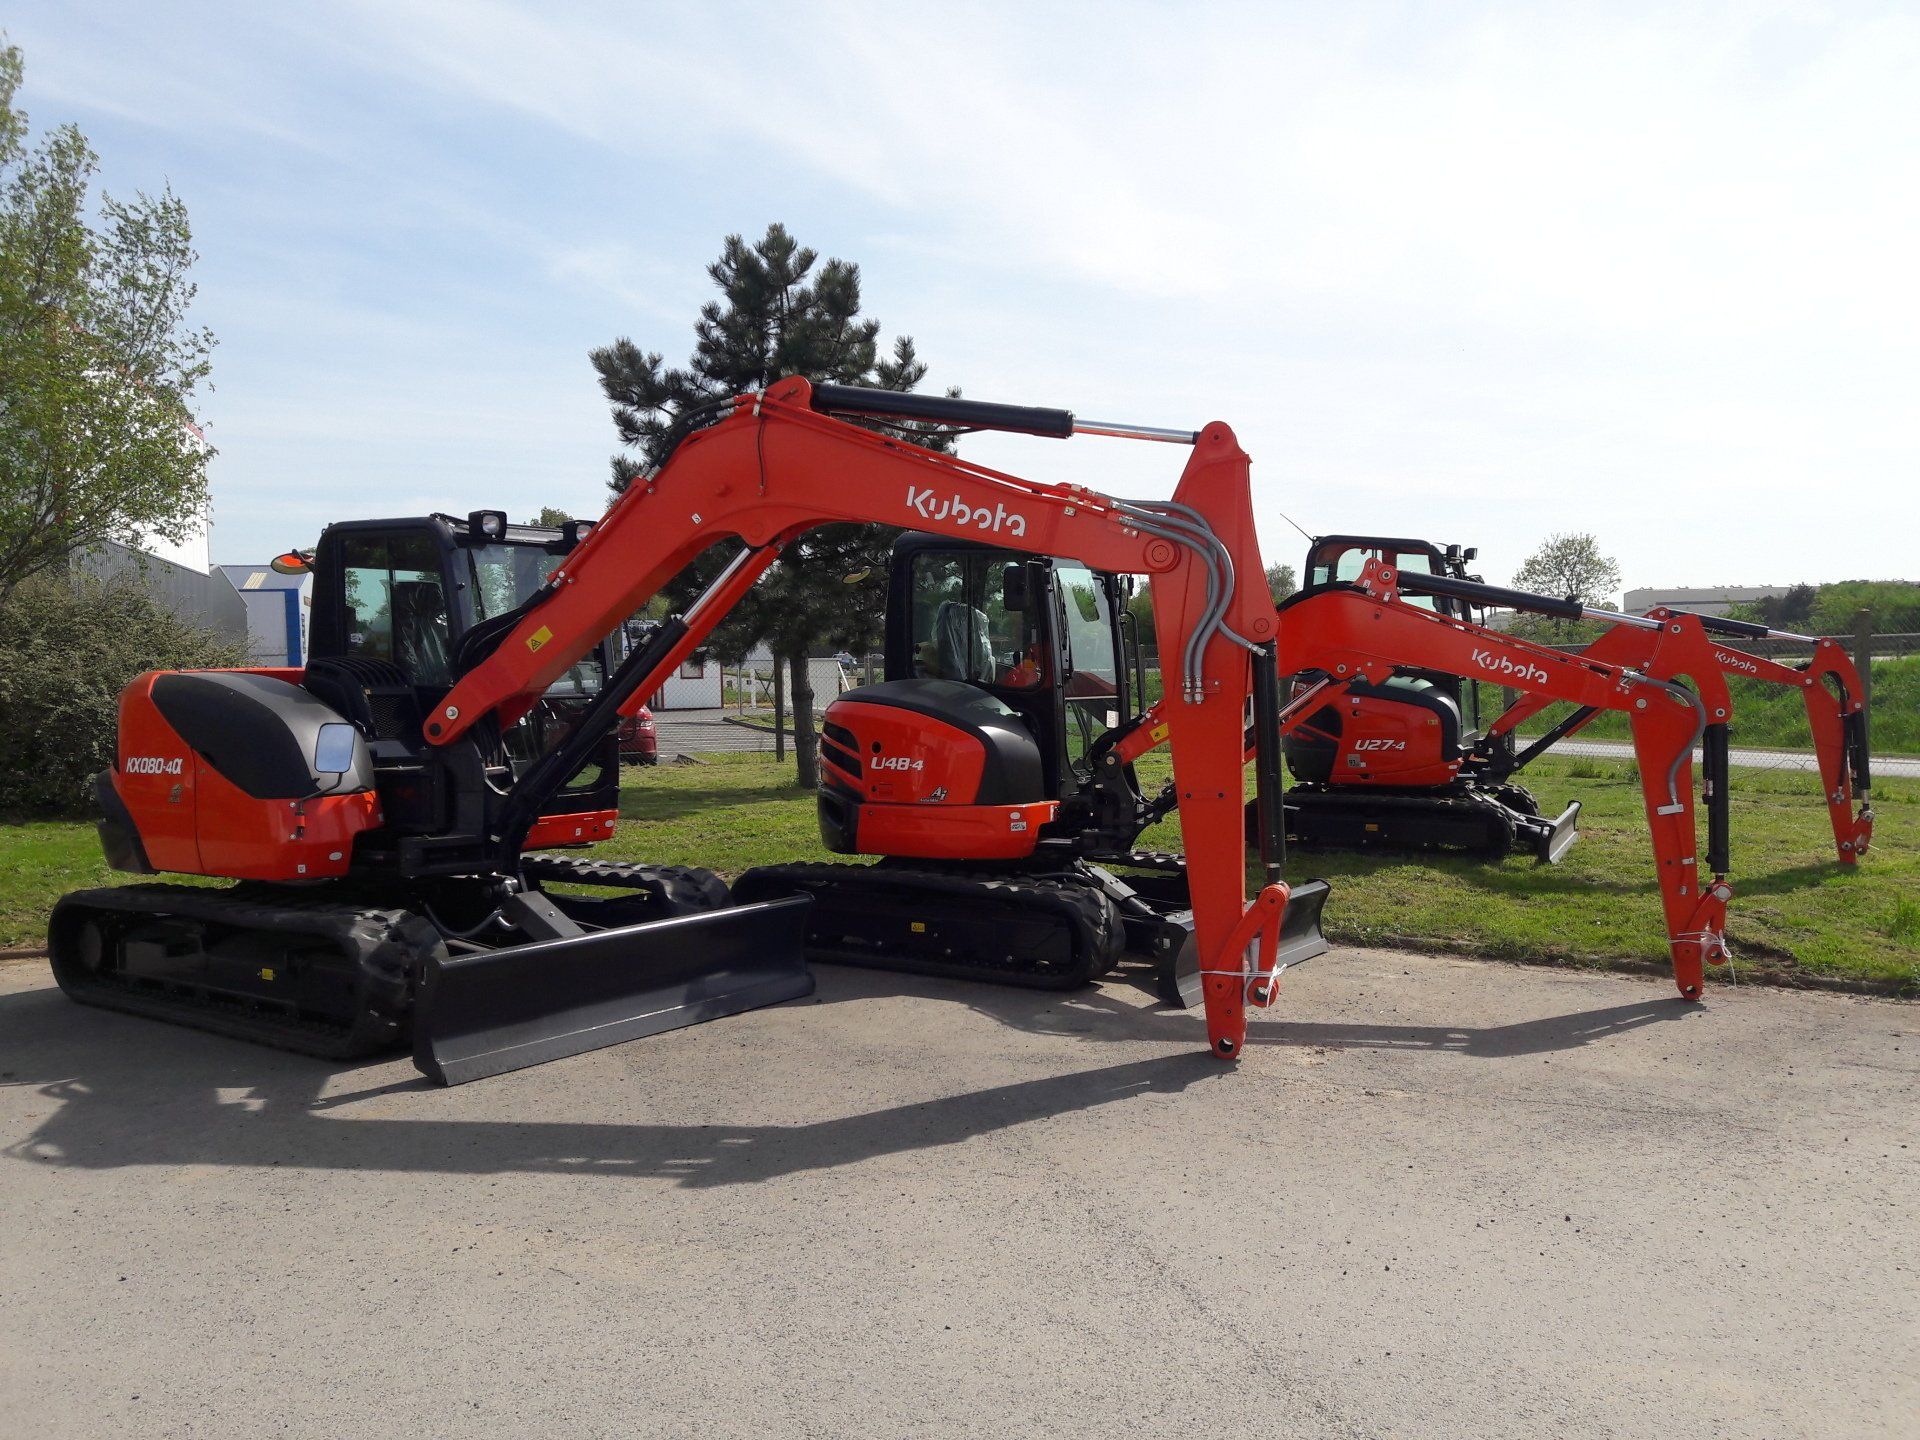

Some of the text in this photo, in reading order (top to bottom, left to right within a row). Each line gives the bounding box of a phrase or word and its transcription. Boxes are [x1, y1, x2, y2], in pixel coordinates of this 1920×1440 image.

[906, 485, 1026, 537] Kubota
[1471, 648, 1548, 684] Kubota
[1714, 651, 1757, 673] Kubota
[1354, 739, 1406, 751] U27-4
[870, 756, 924, 771] U48-4
